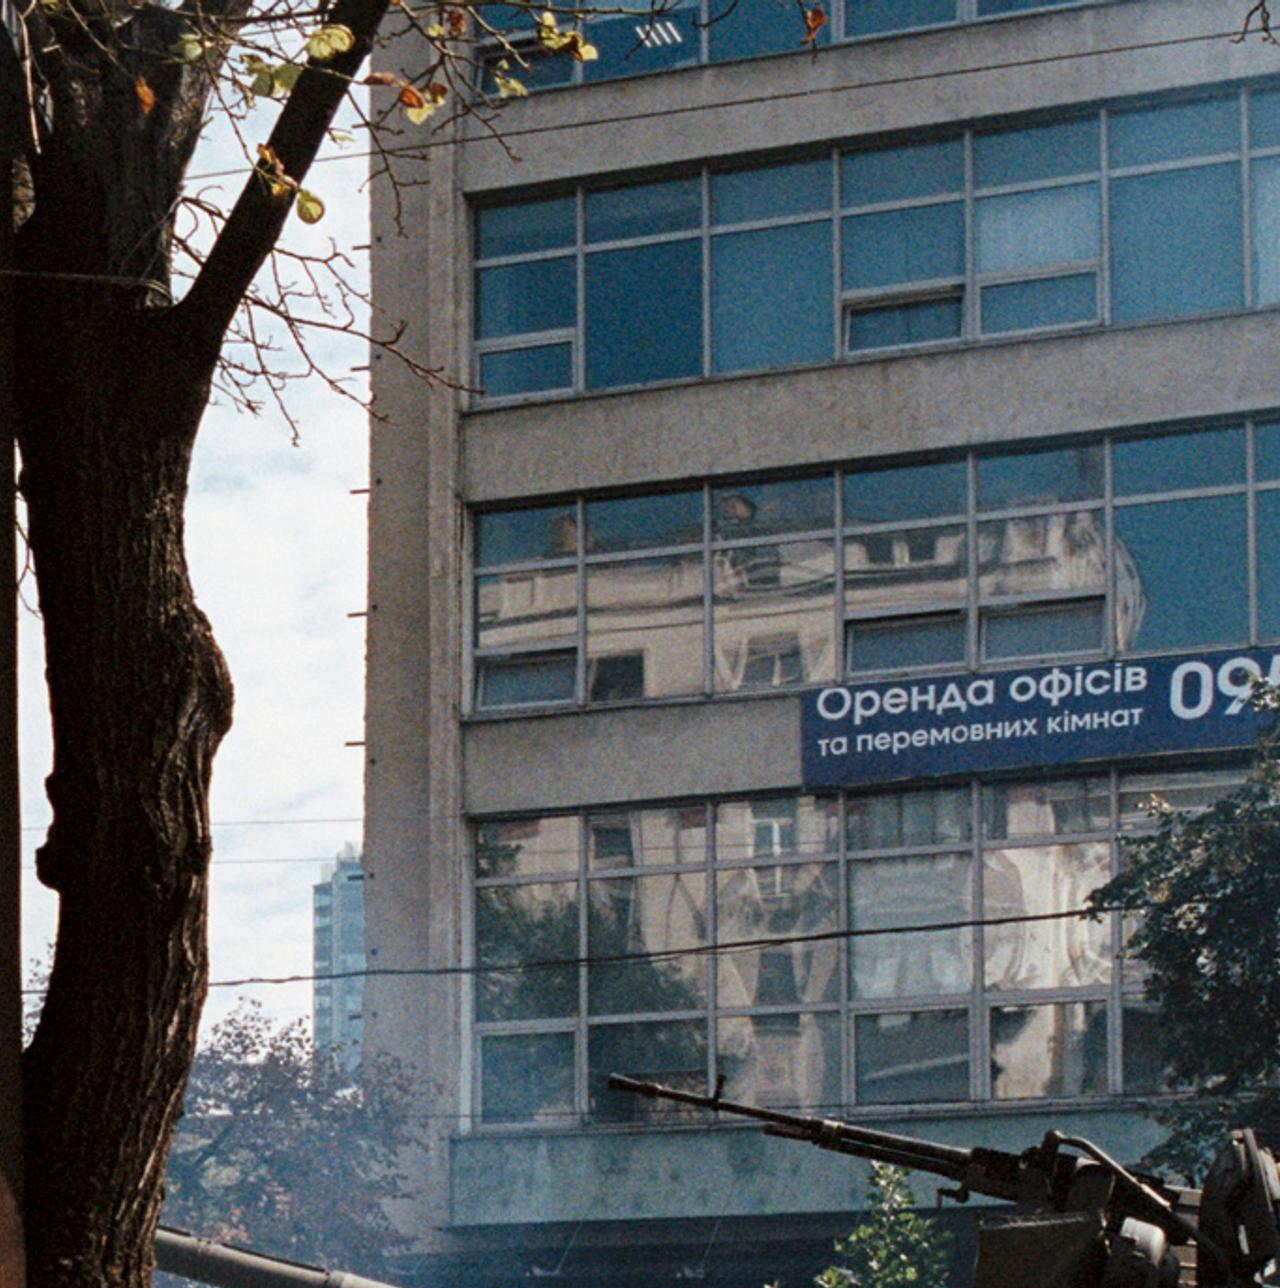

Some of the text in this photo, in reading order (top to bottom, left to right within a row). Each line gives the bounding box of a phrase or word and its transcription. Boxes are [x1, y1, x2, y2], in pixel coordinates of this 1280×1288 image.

[817, 662, 1148, 725] Оренда офісів
[817, 707, 1144, 757] та перемовних кімнат
